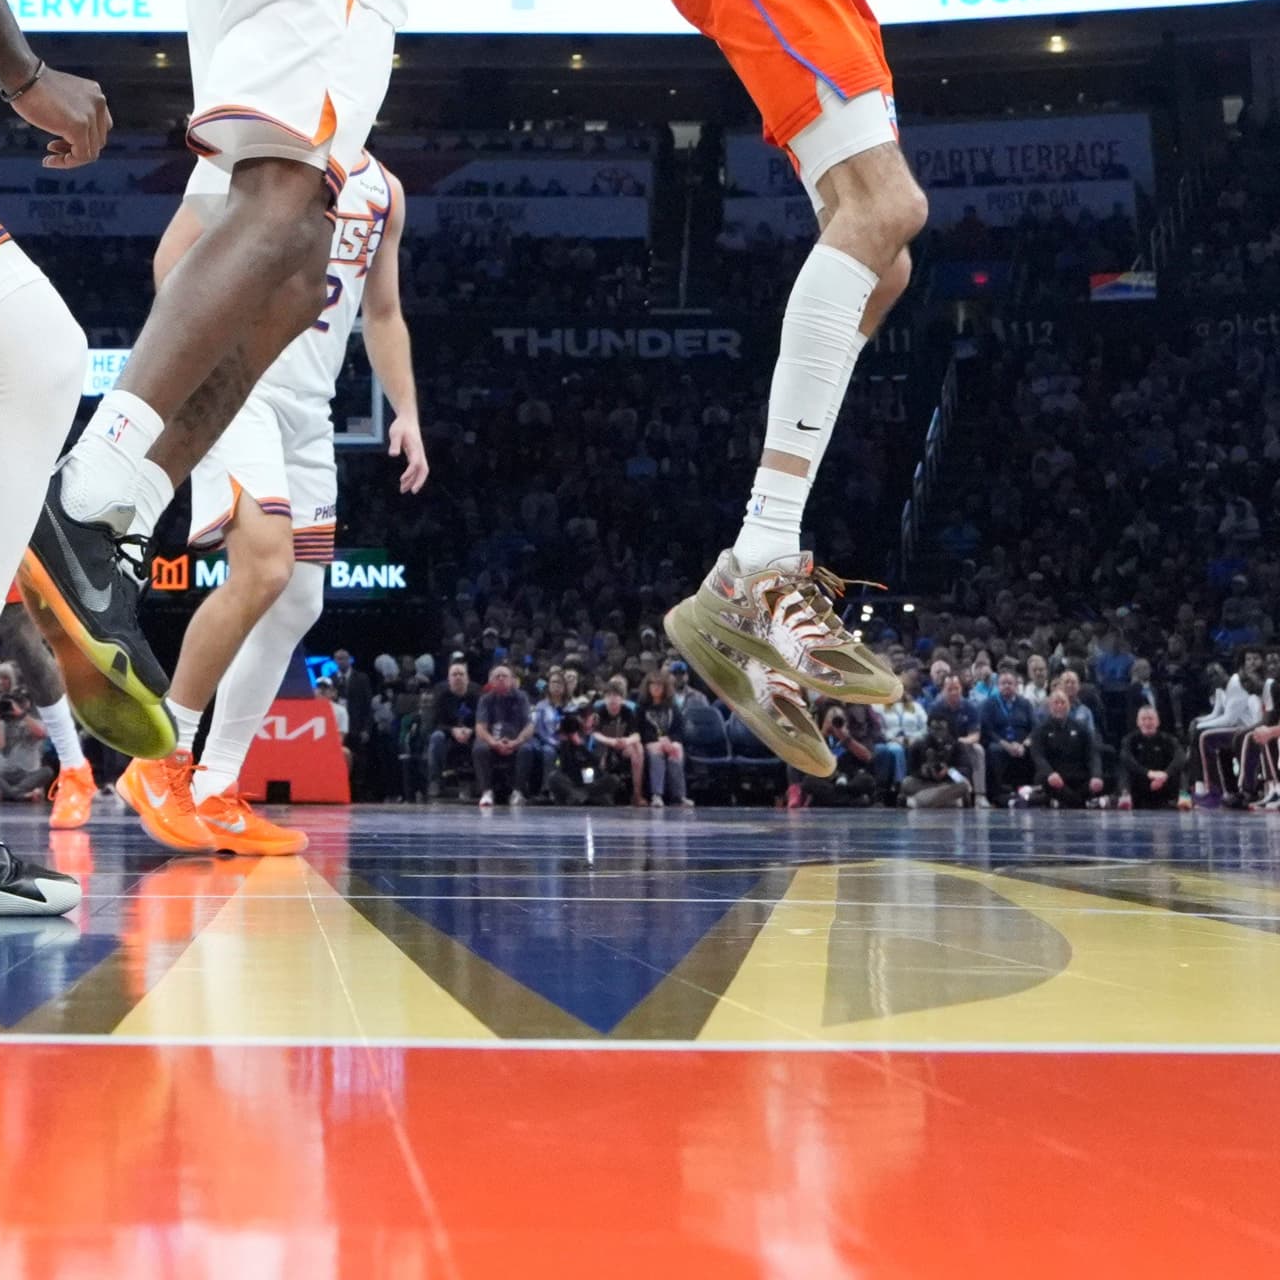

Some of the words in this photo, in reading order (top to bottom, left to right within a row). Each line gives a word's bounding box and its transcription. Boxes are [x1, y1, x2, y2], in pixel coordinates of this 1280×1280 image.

[916, 147, 996, 178] PARTY
[1005, 139, 1122, 173] TERRACE
[494, 327, 741, 359] THUNDER
[331, 561, 407, 588] BANK
